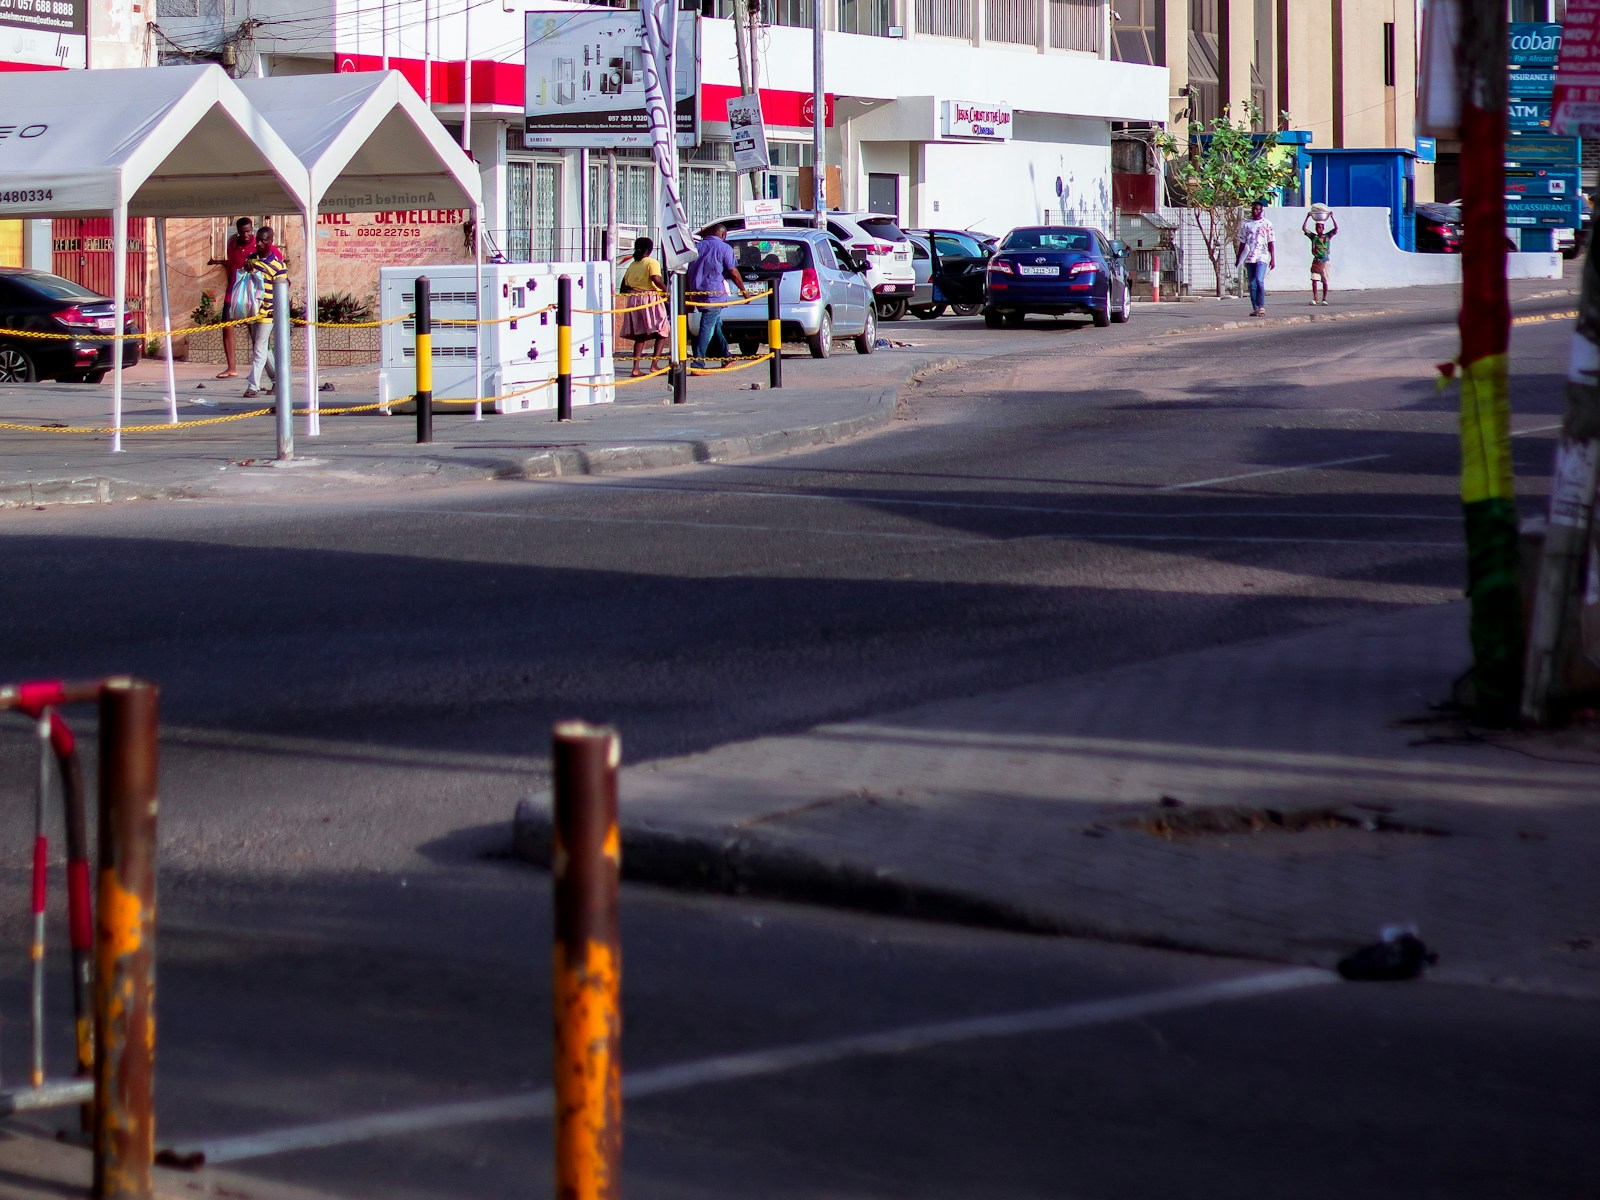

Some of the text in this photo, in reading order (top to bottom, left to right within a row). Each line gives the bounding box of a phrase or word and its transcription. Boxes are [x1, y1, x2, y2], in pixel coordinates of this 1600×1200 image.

[35, 0, 51, 13] 688
[53, 1, 74, 16] 8888
[1508, 30, 1563, 50] coban
[1509, 106, 1538, 117] ATM
[1505, 203, 1573, 212] ANCASSURANCE
[358, 229, 381, 237] 0302
[384, 229, 421, 237] 227513
